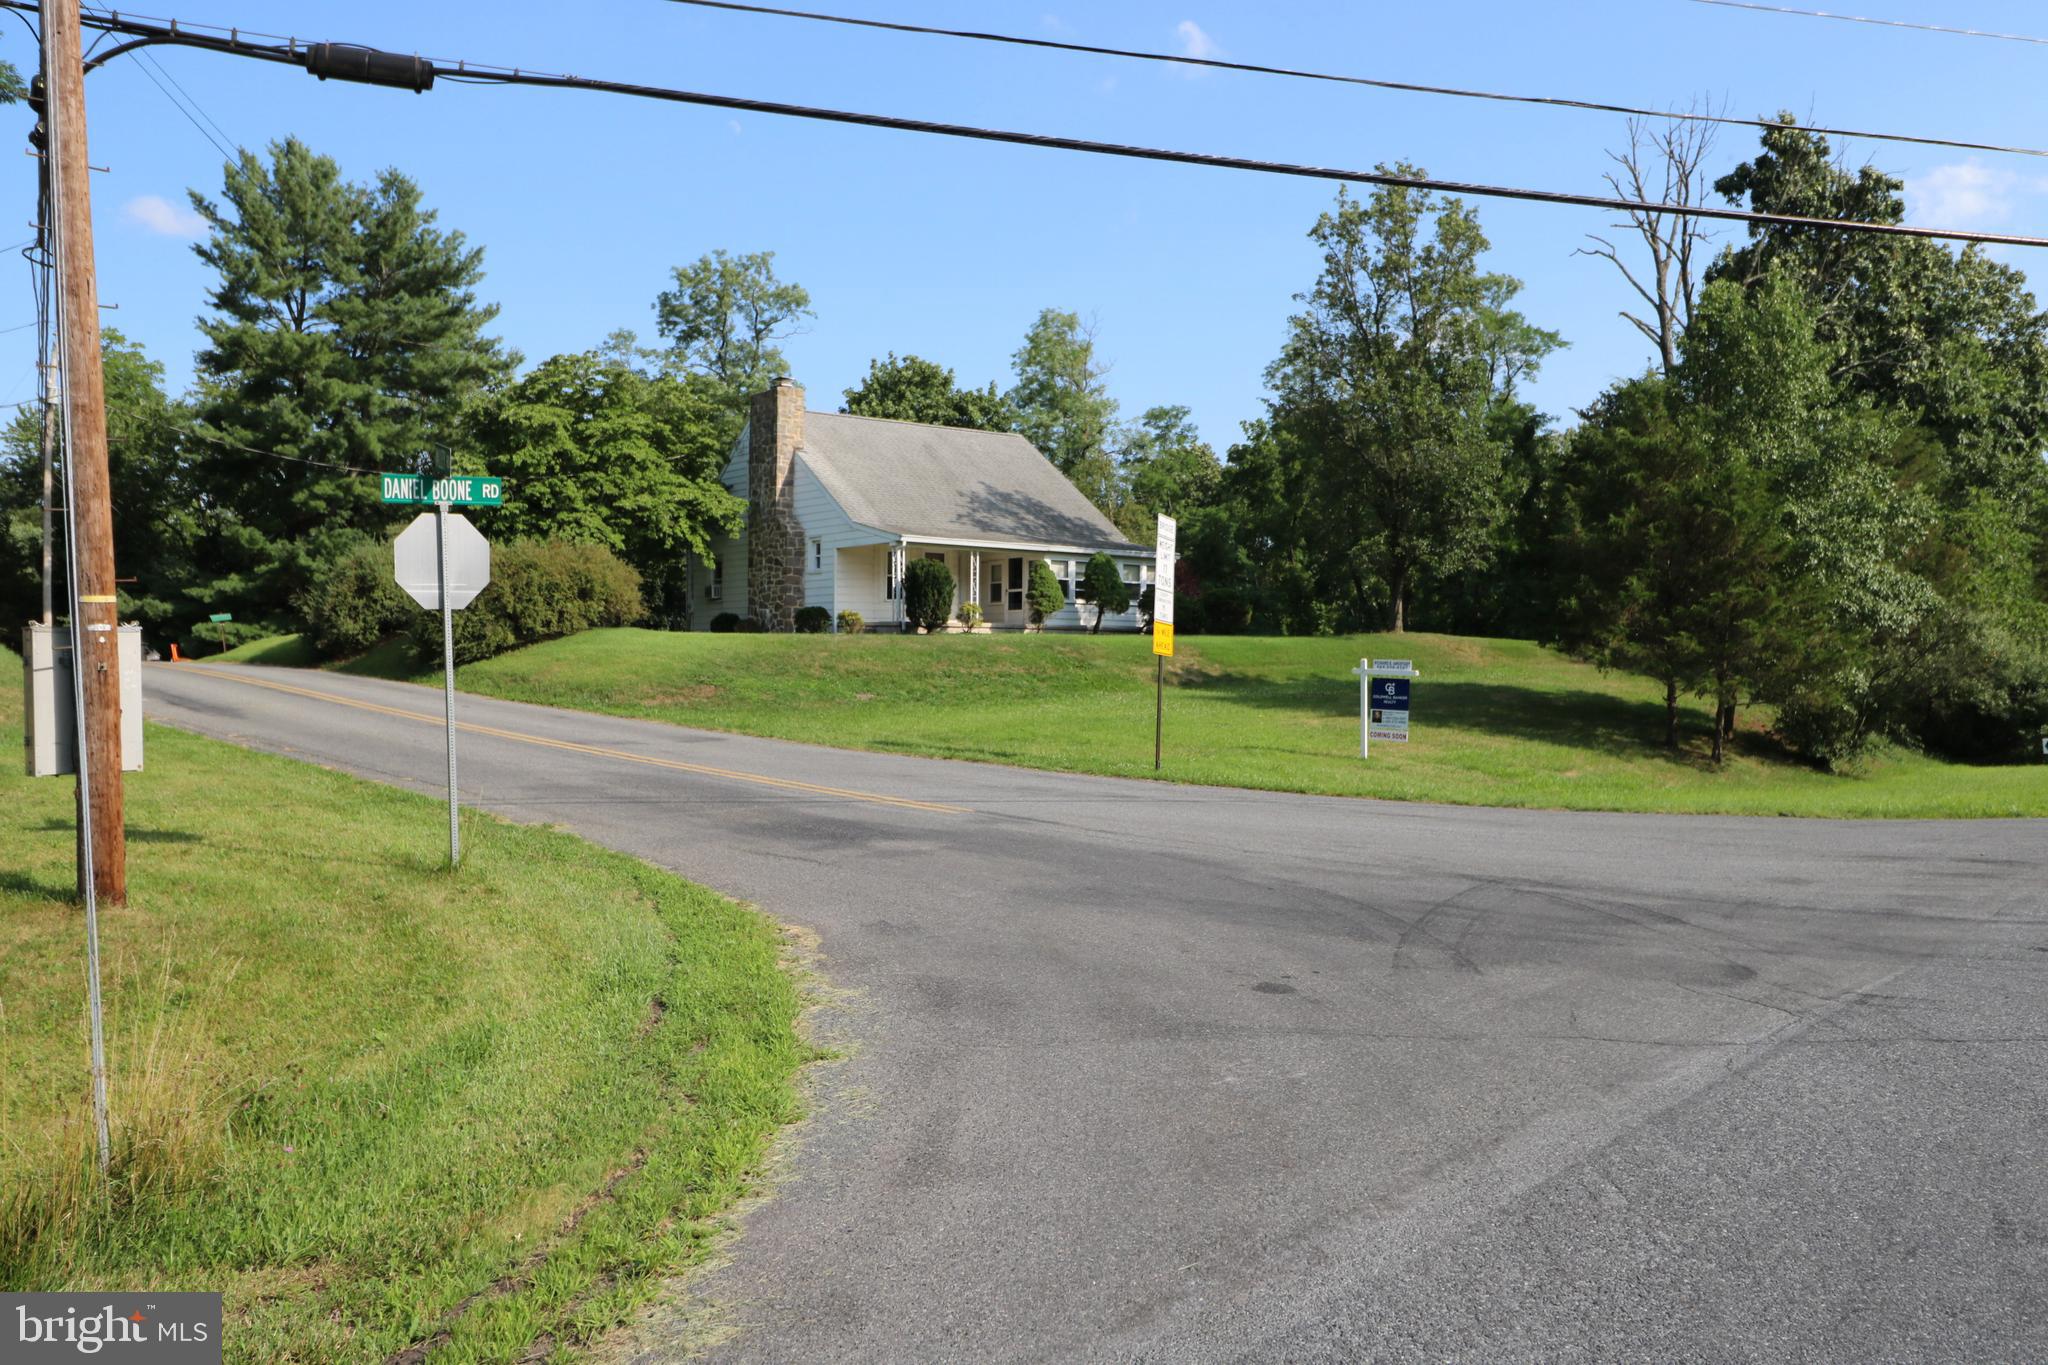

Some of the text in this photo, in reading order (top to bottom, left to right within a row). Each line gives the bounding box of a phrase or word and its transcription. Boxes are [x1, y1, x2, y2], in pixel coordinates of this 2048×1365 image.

[384, 478, 499, 501] DANIEL BOONE RD
[1159, 540, 1173, 551] WEIGHT
[1160, 551, 1171, 561] LIMIT
[1158, 574, 1171, 588] TONS
[1370, 731, 1390, 739] COMING
